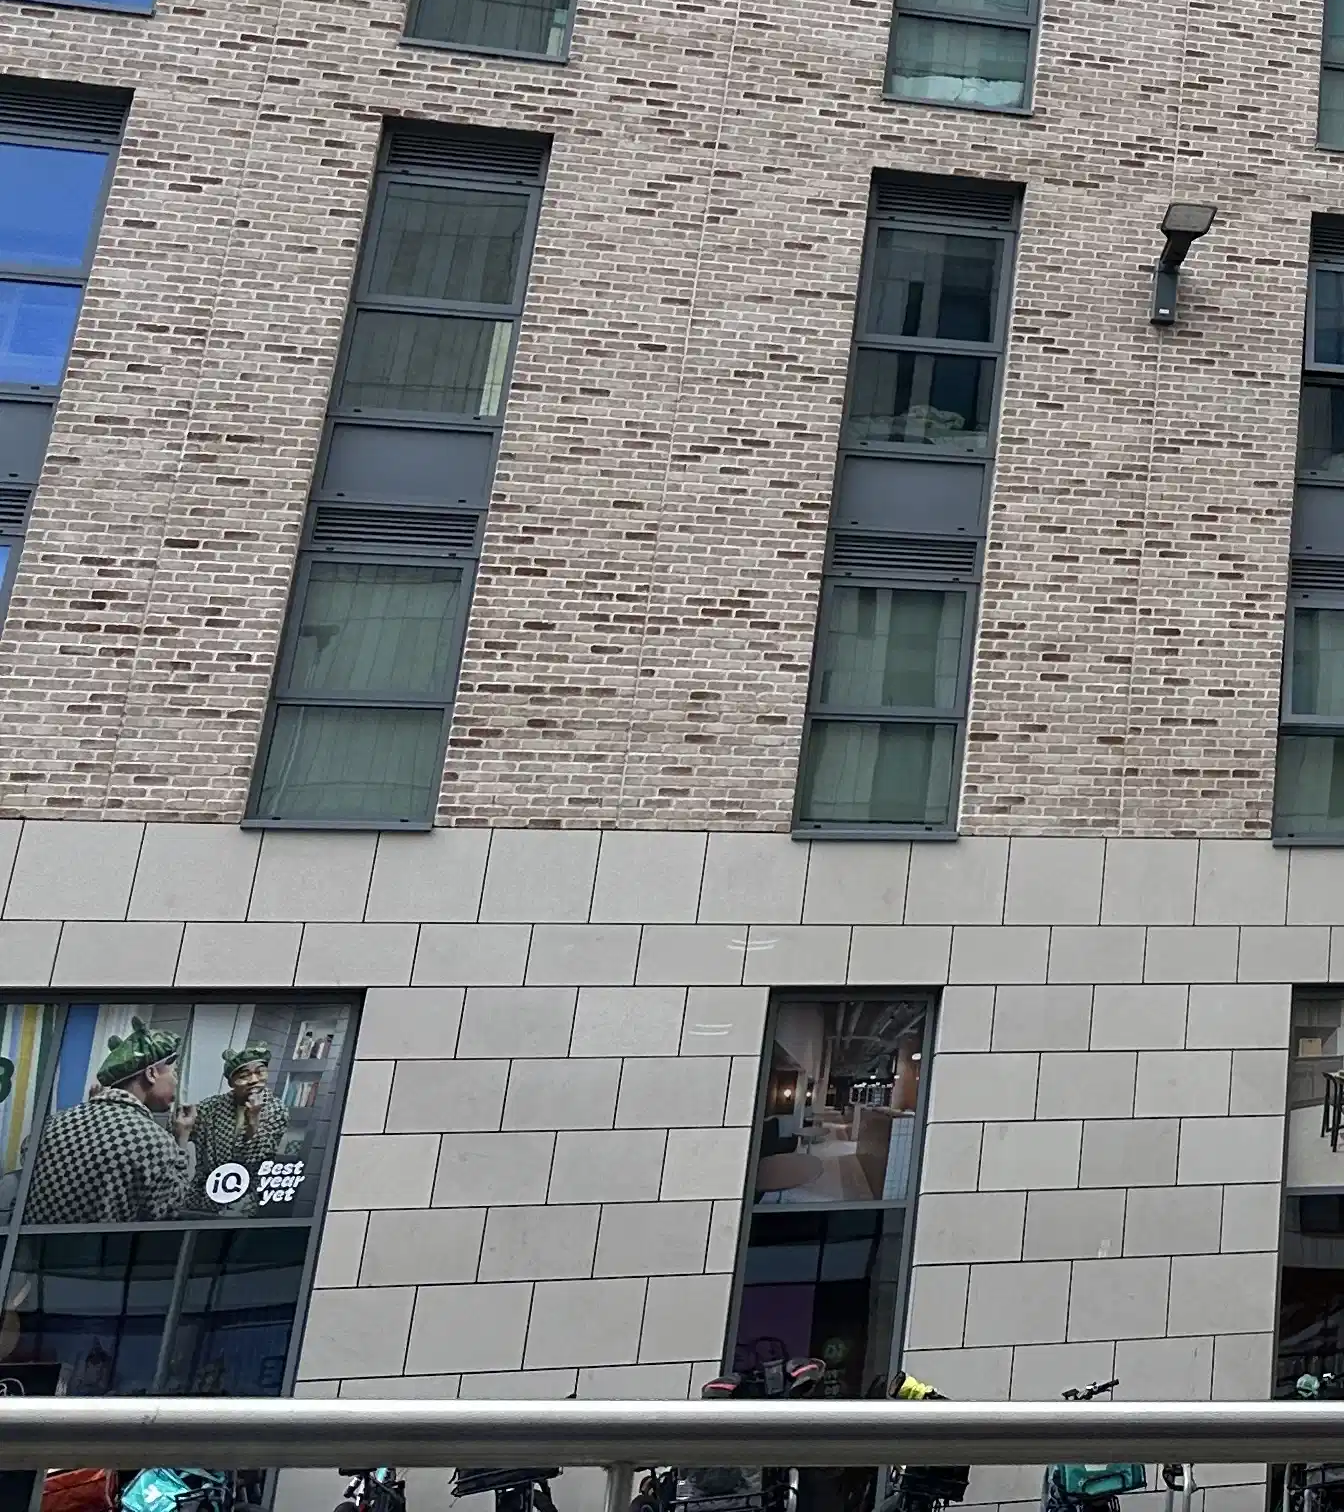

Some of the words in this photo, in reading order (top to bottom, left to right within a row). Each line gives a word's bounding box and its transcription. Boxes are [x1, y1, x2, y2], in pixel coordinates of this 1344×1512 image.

[258, 1160, 305, 1176] Best
[212, 1172, 242, 1194] iQ
[256, 1175, 305, 1192] year
[259, 1187, 295, 1206] yet
